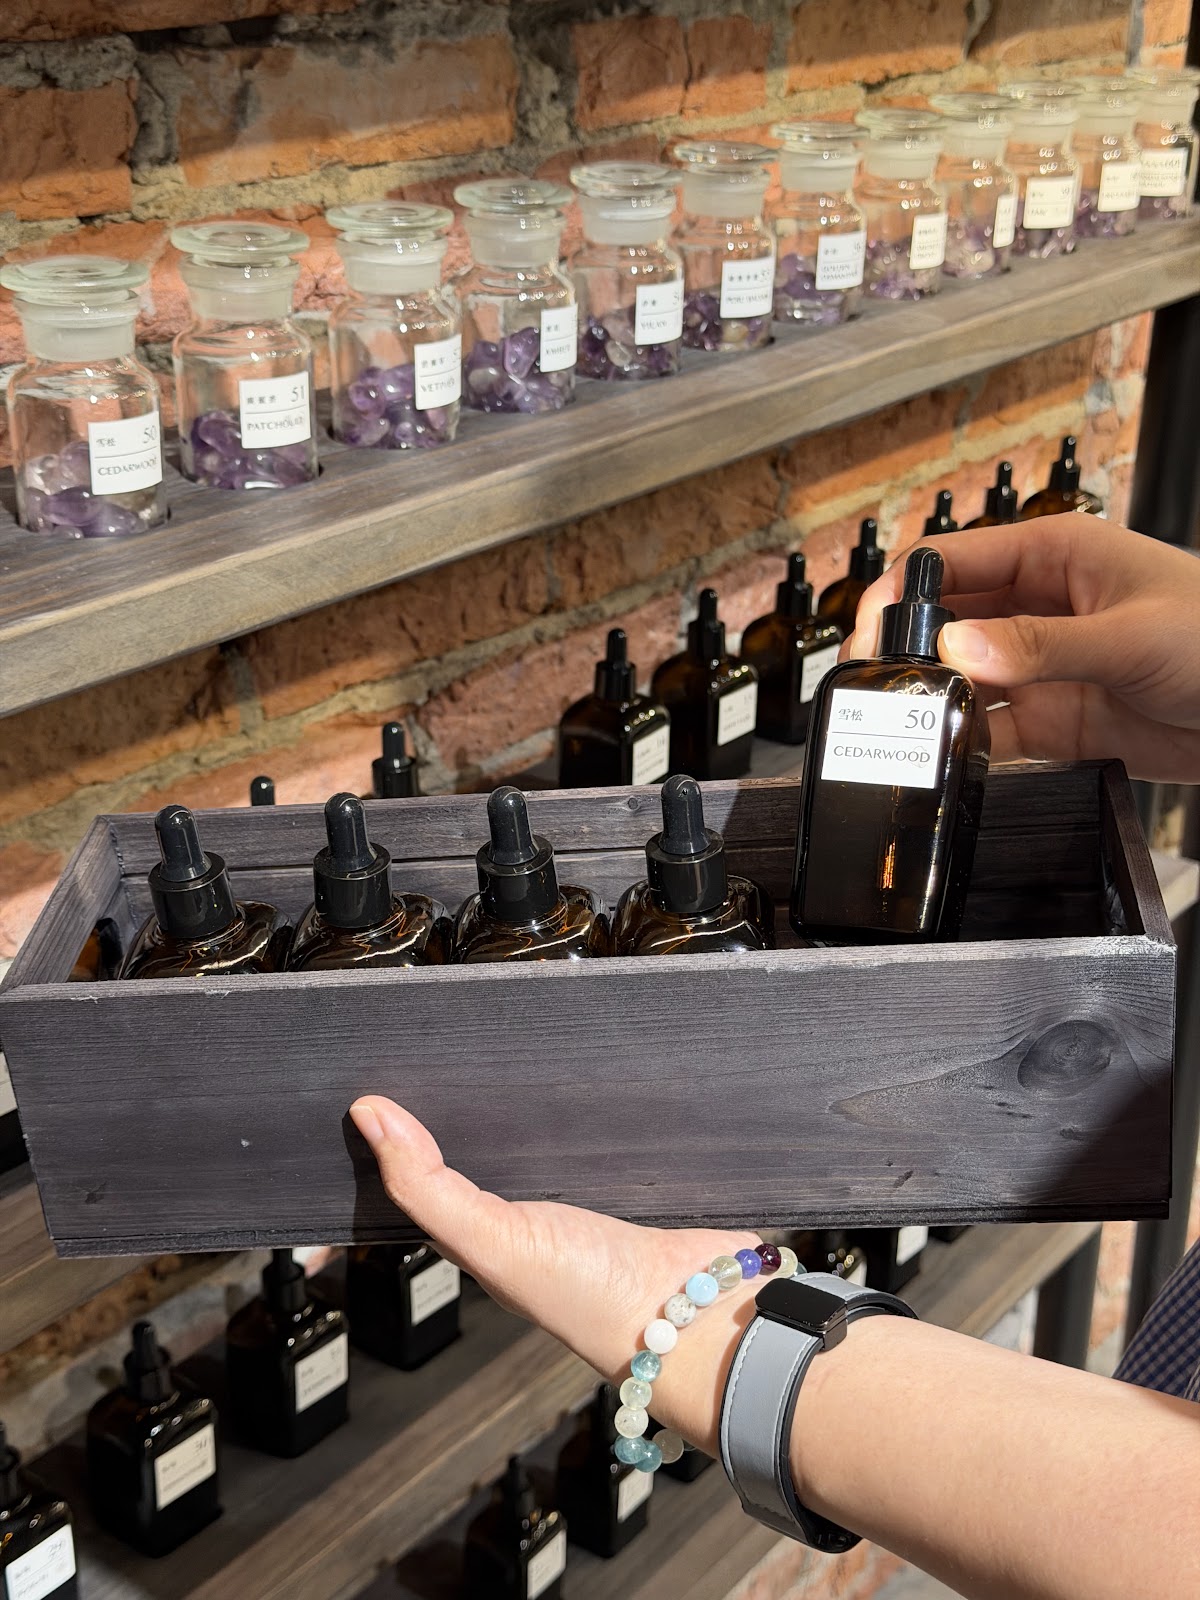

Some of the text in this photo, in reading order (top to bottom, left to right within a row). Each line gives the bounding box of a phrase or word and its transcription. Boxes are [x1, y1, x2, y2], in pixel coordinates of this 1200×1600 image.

[291, 385, 305, 402] 51
[143, 425, 157, 444] 50
[838, 708, 863, 722] 雪松
[904, 709, 936, 731] 50
[833, 745, 931, 763] CEDARWOOD
